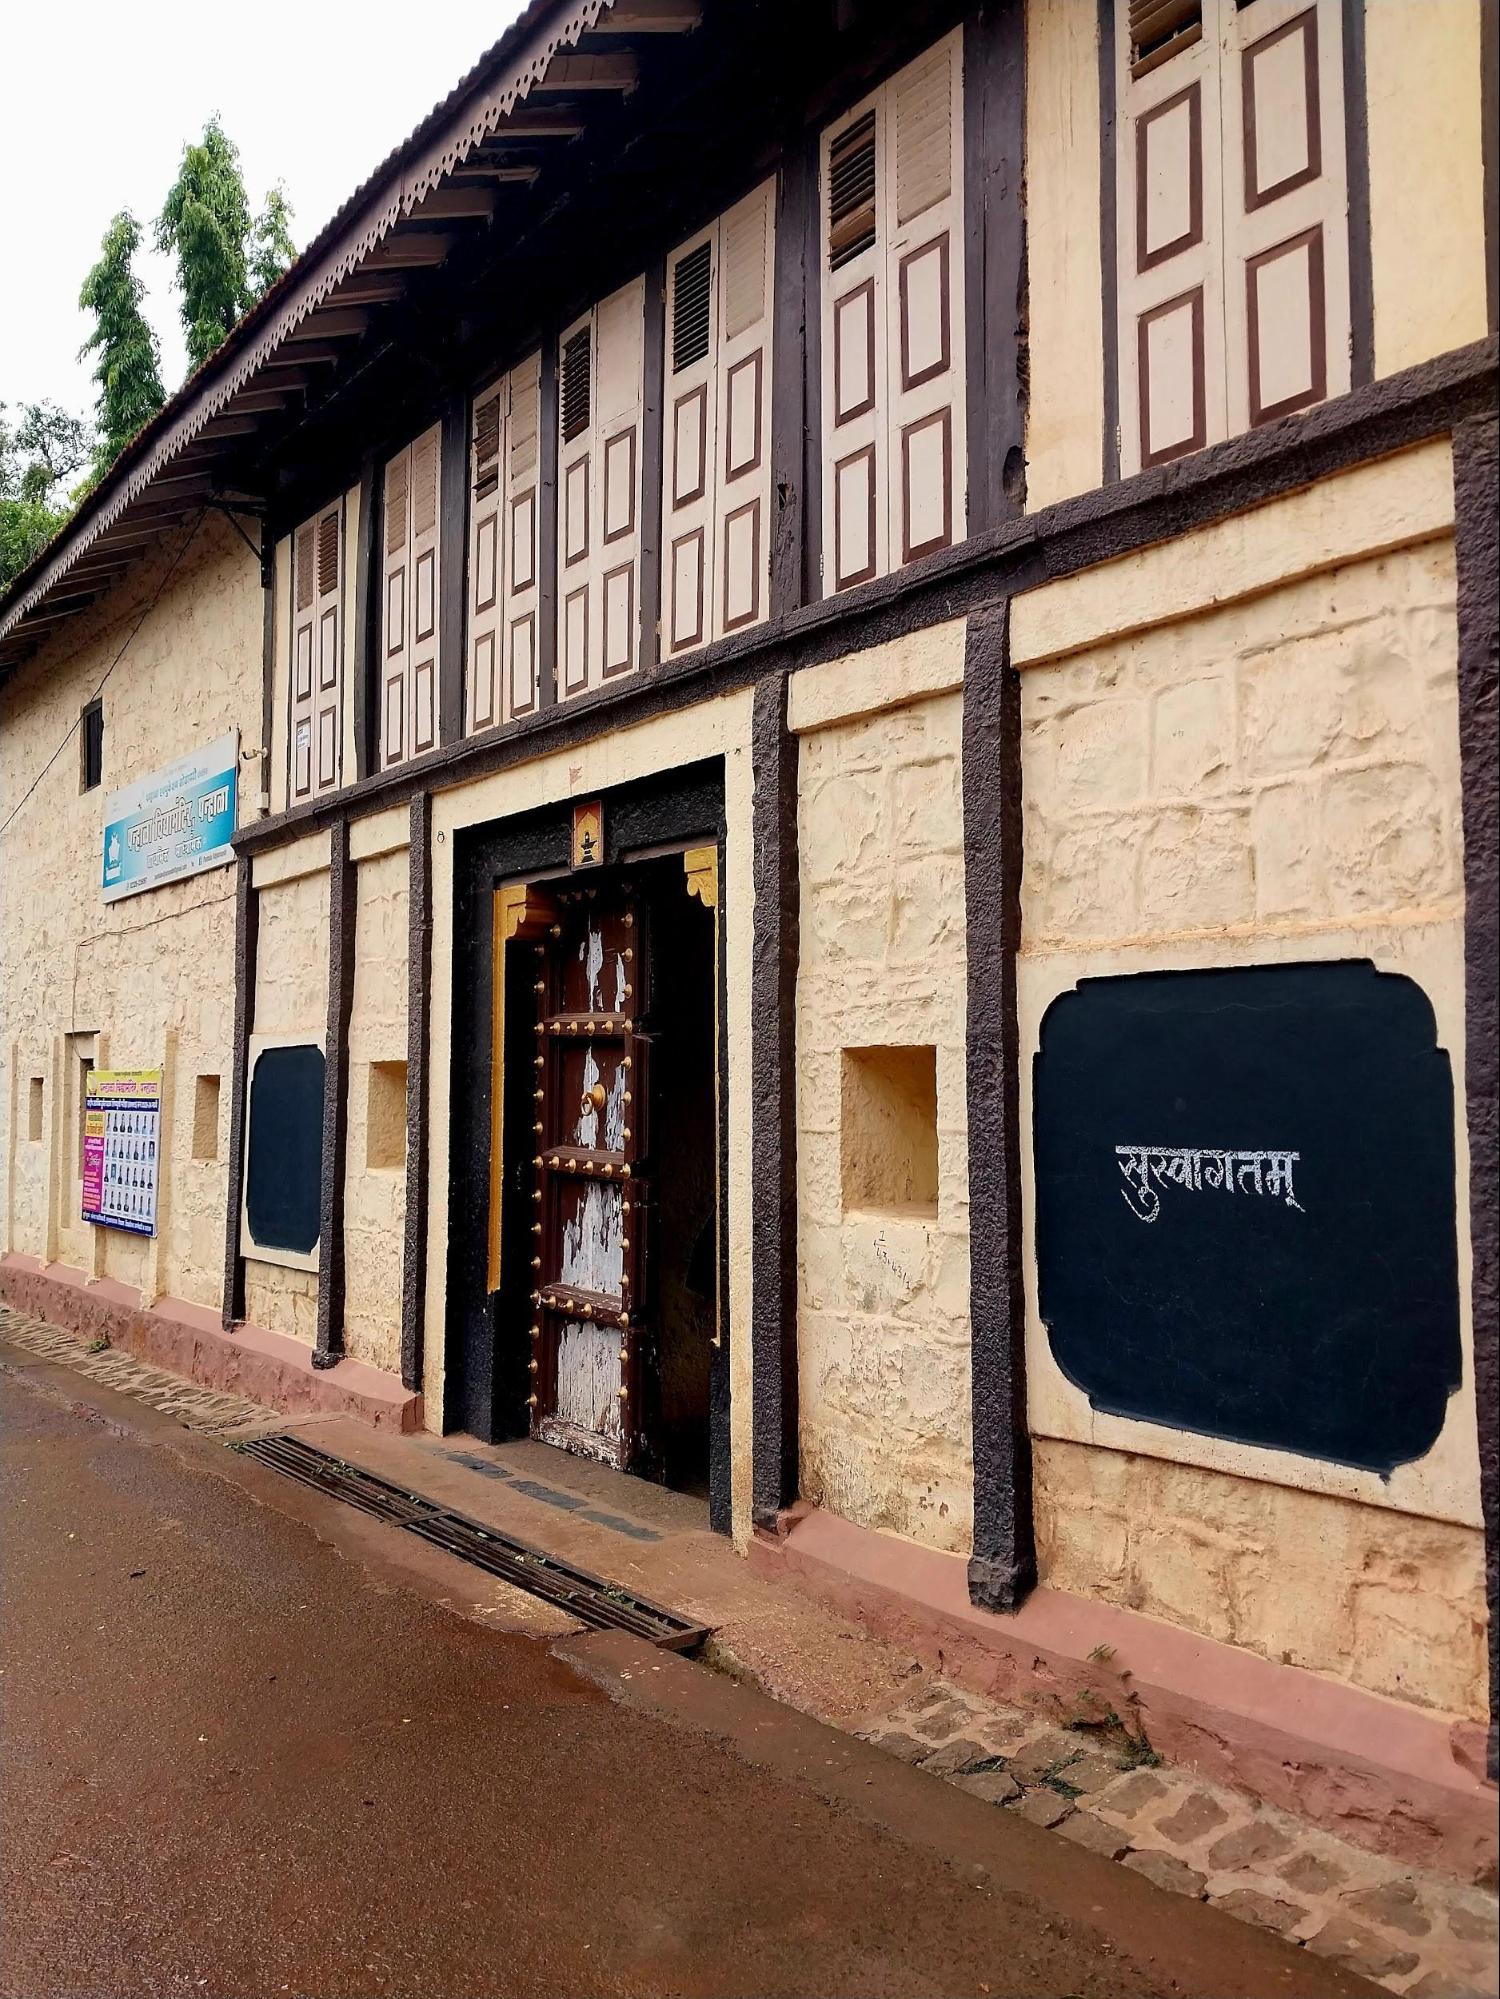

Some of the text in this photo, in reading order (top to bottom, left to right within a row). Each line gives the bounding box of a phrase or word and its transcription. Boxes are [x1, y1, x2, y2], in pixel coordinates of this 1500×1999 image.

[127, 818, 153, 852] पन्हाळा
[198, 785, 229, 823] पन्हाळा
[1115, 1145, 1306, 1223] सुस्वागतम्
